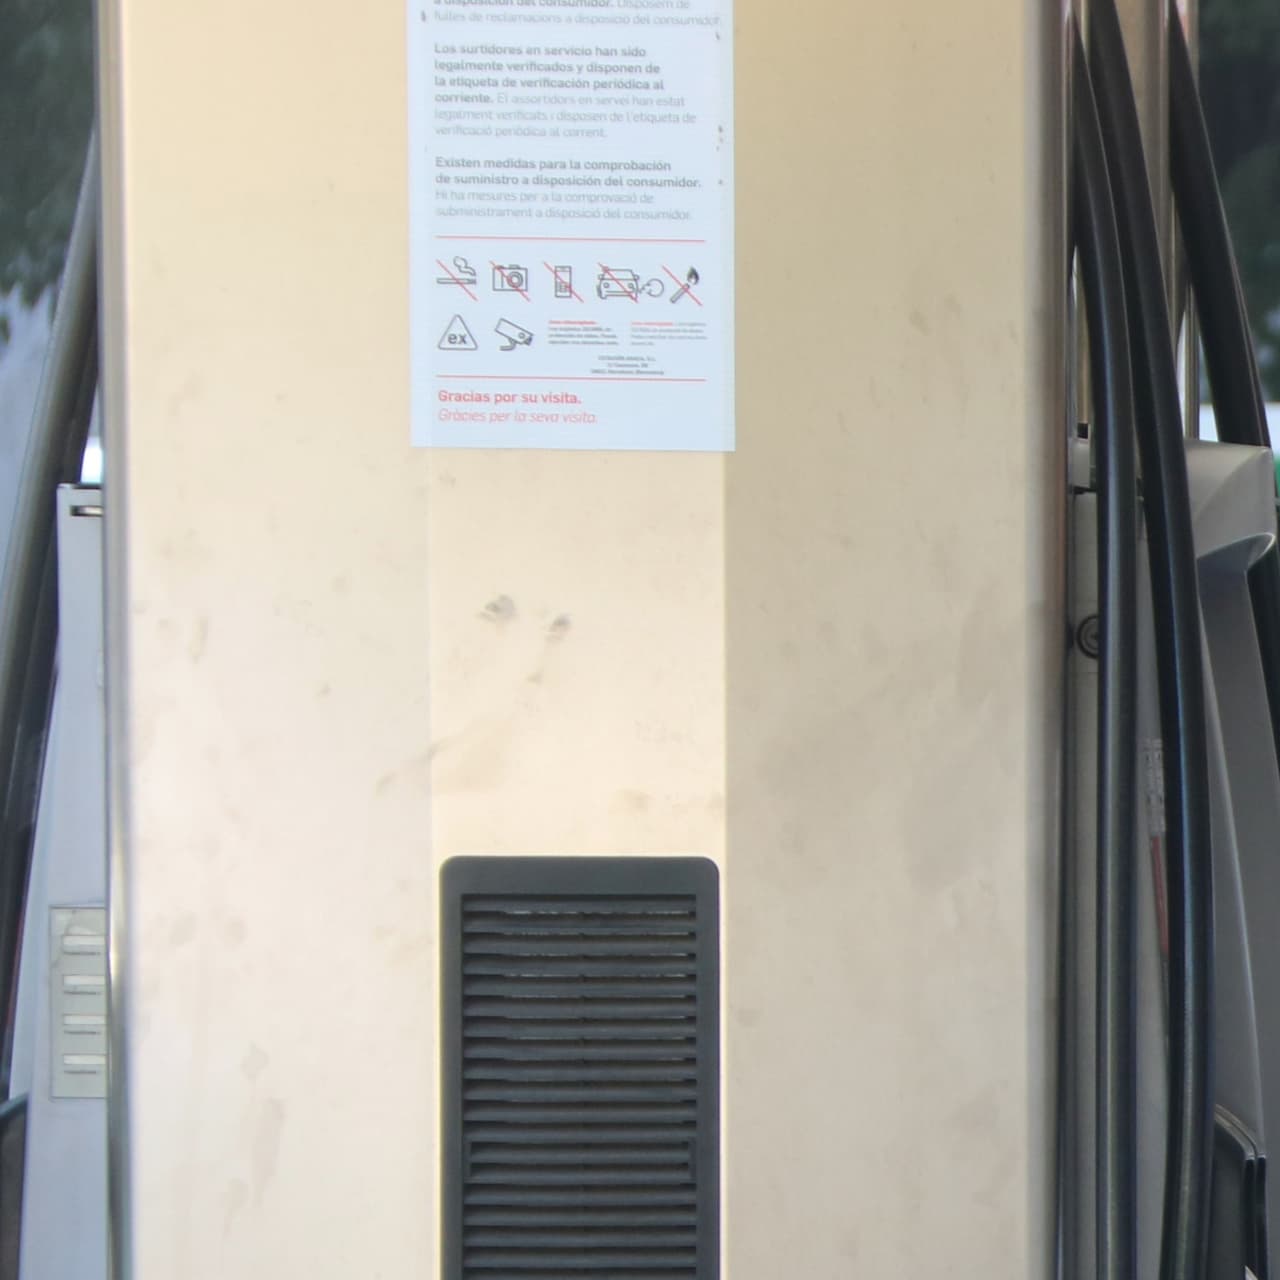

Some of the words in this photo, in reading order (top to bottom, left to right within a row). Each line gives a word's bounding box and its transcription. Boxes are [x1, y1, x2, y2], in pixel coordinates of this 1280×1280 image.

[434, 43, 457, 54] Los
[460, 44, 523, 55] surtidores
[526, 46, 541, 55] en
[544, 46, 592, 56] servicio
[595, 46, 617, 56] han
[621, 46, 647, 57] sido
[434, 60, 503, 72] legalmente
[506, 61, 574, 72] verificados
[576, 63, 583, 74] y
[586, 62, 642, 74] disponen
[645, 62, 661, 73] de
[434, 76, 446, 87] la
[449, 77, 498, 89] etiqueta
[502, 77, 517, 88] de
[520, 77, 590, 89] verificación
[593, 78, 650, 91] periódica
[653, 79, 664, 90] al
[435, 156, 481, 168] Existen
[483, 157, 536, 169] medidas
[538, 159, 567, 172] para
[569, 159, 581, 170] la
[584, 160, 672, 172] comprobación
[435, 173, 451, 185] de
[454, 174, 519, 185] suministro
[521, 176, 529, 185] a
[532, 175, 601, 188] disposición
[604, 176, 623, 186] del
[438, 390, 490, 402] Gracias
[494, 391, 517, 405] por
[521, 392, 538, 403] su
[541, 391, 583, 404] visita.
